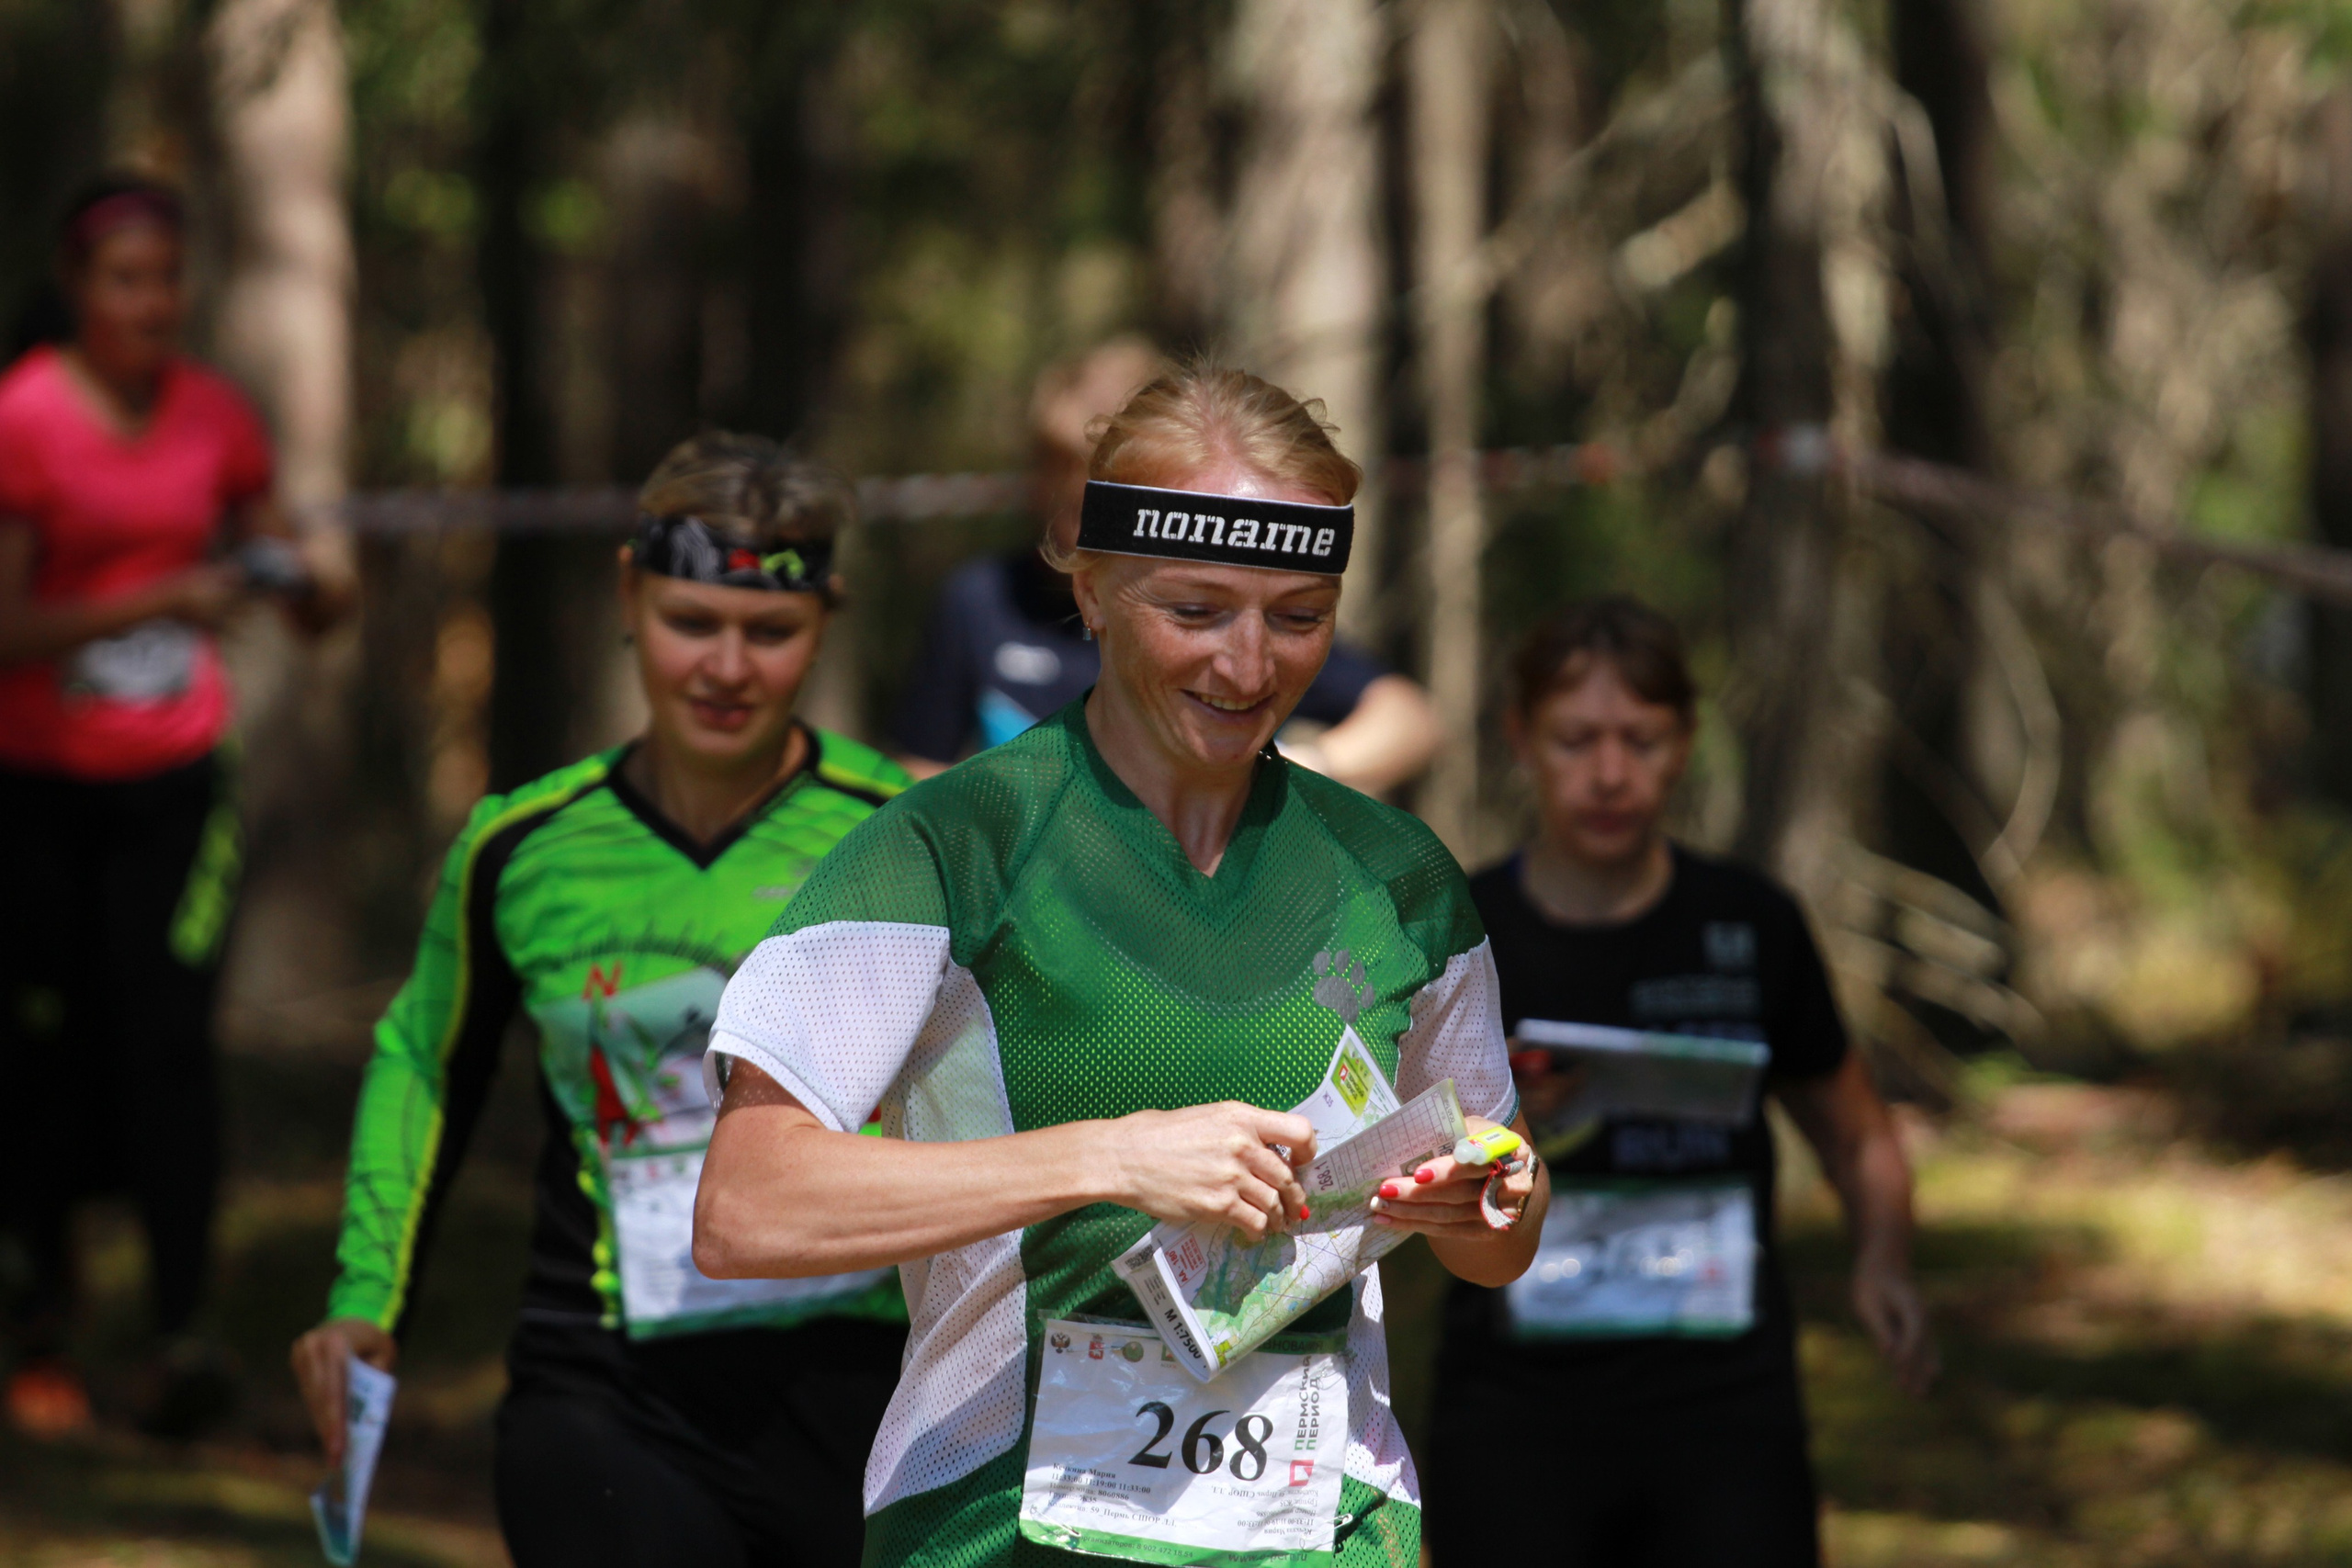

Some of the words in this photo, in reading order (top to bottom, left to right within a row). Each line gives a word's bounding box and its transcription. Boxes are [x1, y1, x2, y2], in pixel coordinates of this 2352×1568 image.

[1133, 508, 1336, 557] noname
[1314, 1160, 1333, 1191] 268.1
[1173, 1322, 1202, 1359] 1:7500
[1306, 1377, 1320, 1450] ПЕРИОД
[1127, 1400, 1274, 1482] 268
[1118, 1483, 1151, 1495] 11:33:00
[1136, 1542, 1142, 1551] 8
[1143, 1544, 1157, 1553] 902
[1158, 1546, 1172, 1555] 472
[1173, 1548, 1182, 1557] 18
[1183, 1550, 1193, 1559] 54
